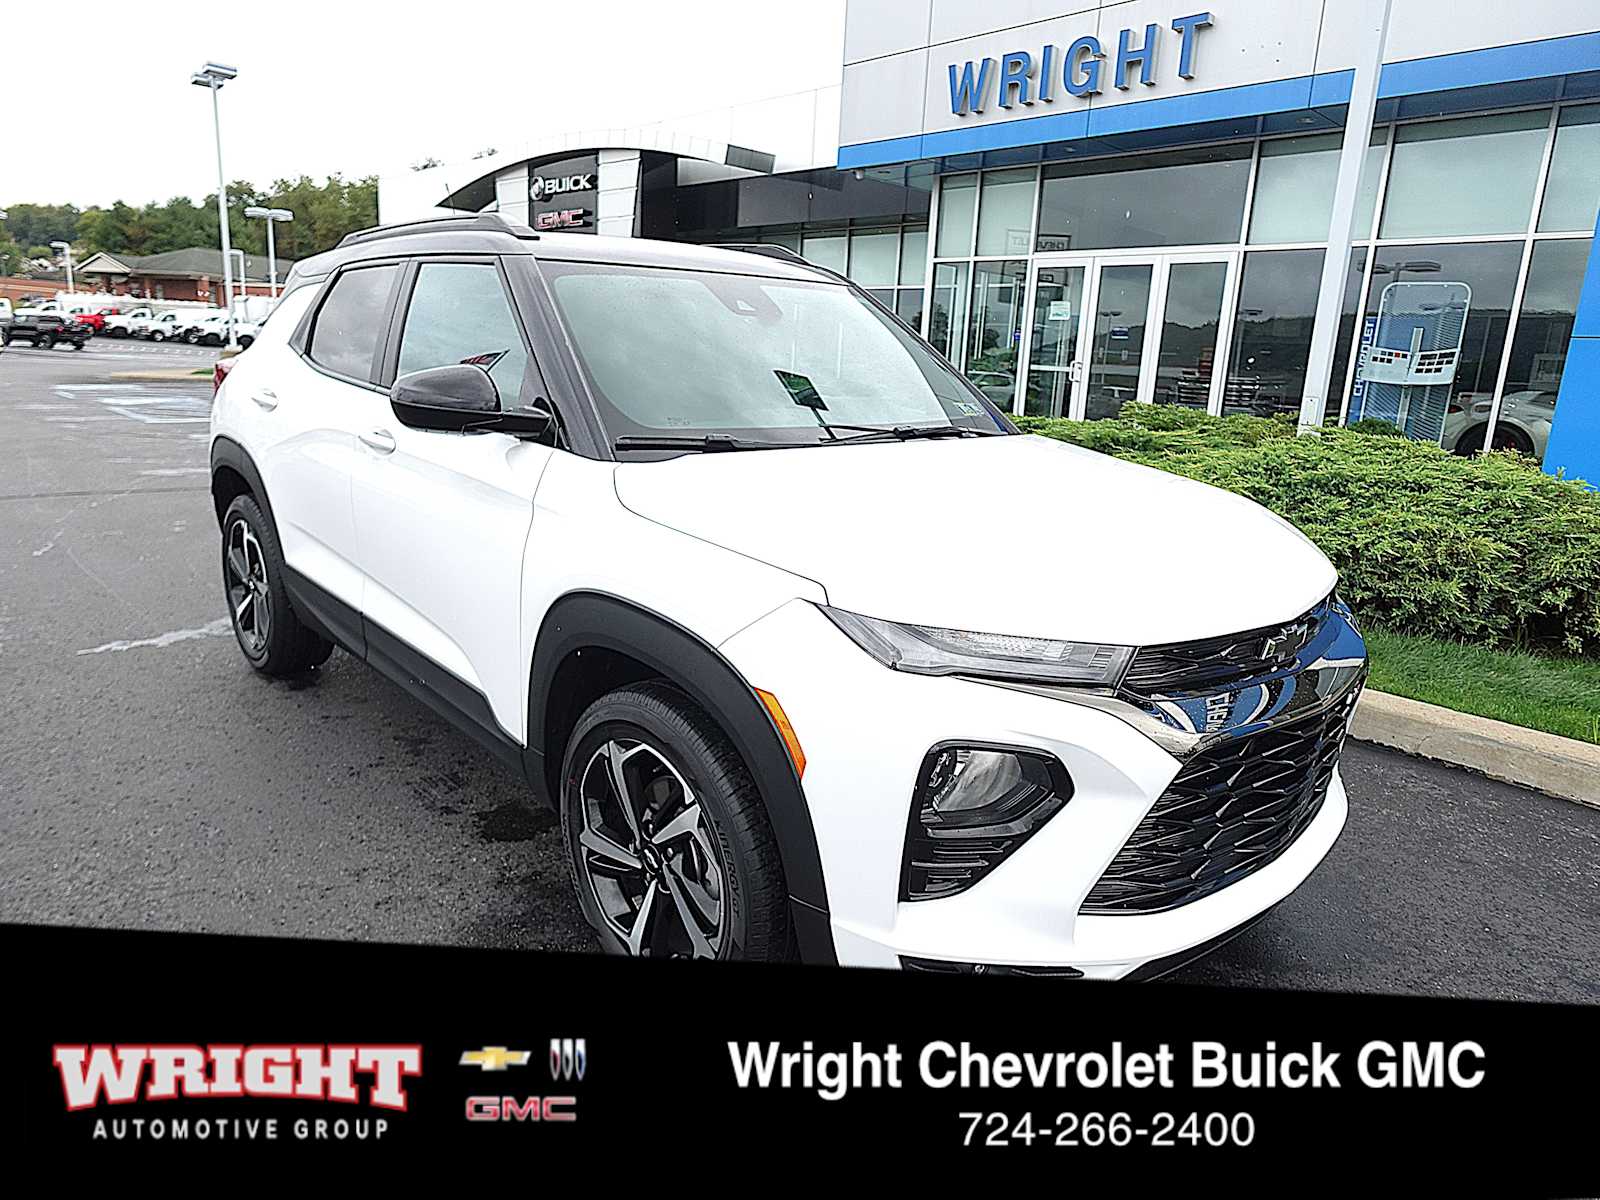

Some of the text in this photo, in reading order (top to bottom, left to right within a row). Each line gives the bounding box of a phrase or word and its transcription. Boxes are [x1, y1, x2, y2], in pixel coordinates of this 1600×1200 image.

[948, 12, 1214, 116] WRIGHT
[545, 174, 592, 194] BUICK
[537, 208, 584, 229] GMC
